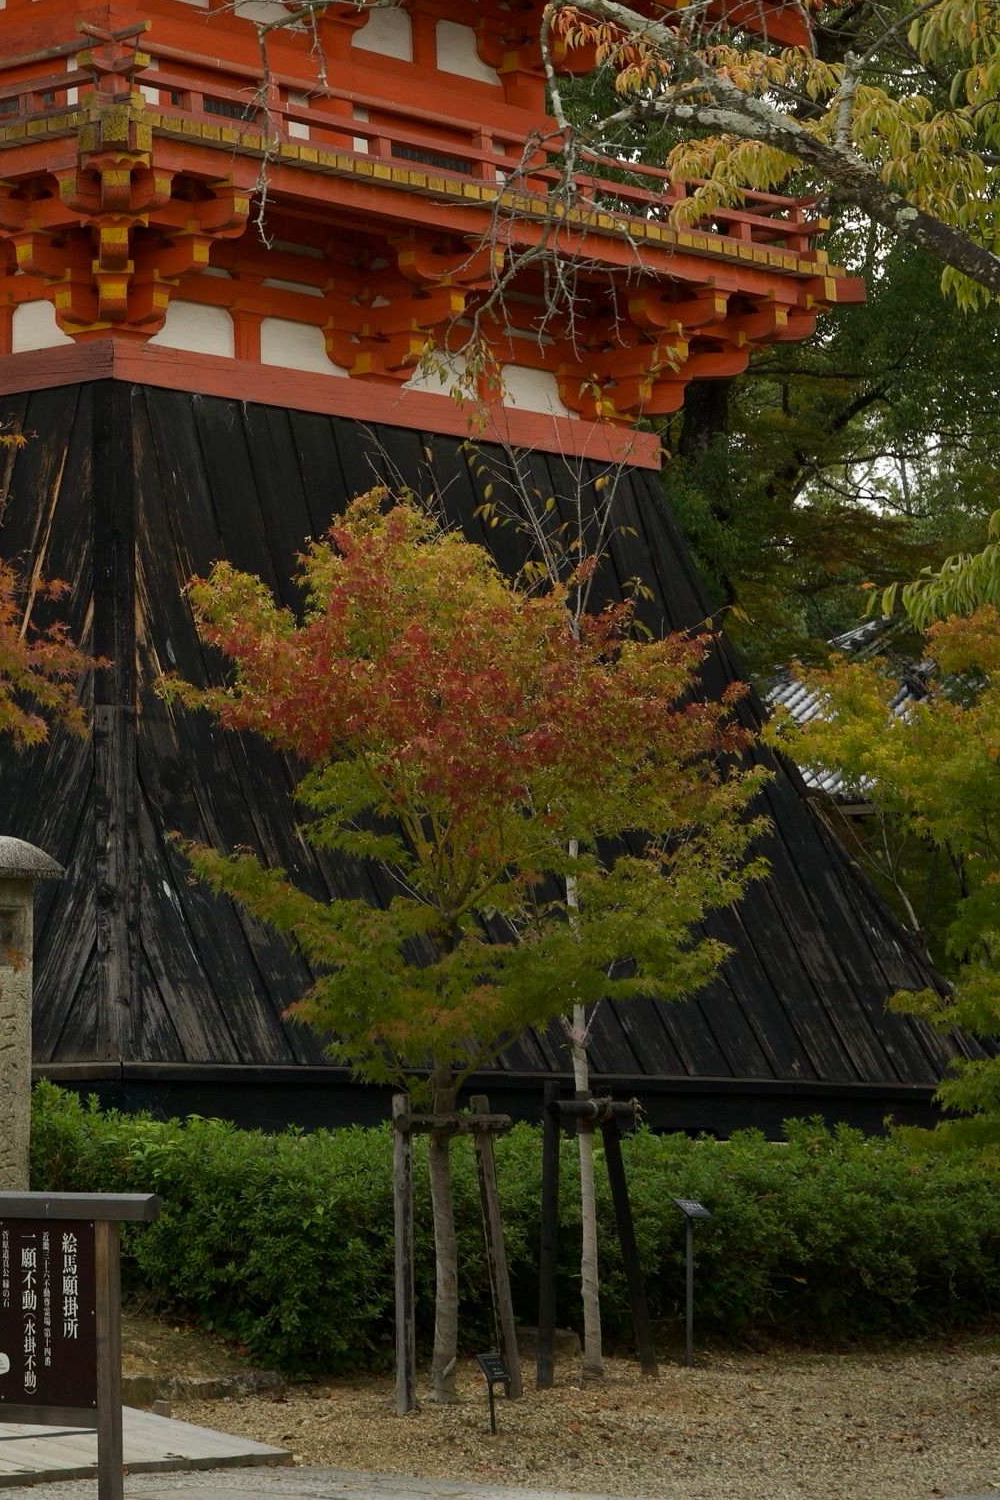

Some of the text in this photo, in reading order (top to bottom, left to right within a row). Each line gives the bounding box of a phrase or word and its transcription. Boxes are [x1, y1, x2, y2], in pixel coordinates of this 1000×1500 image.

[62, 1232, 79, 1339] 絵馬願掛所
